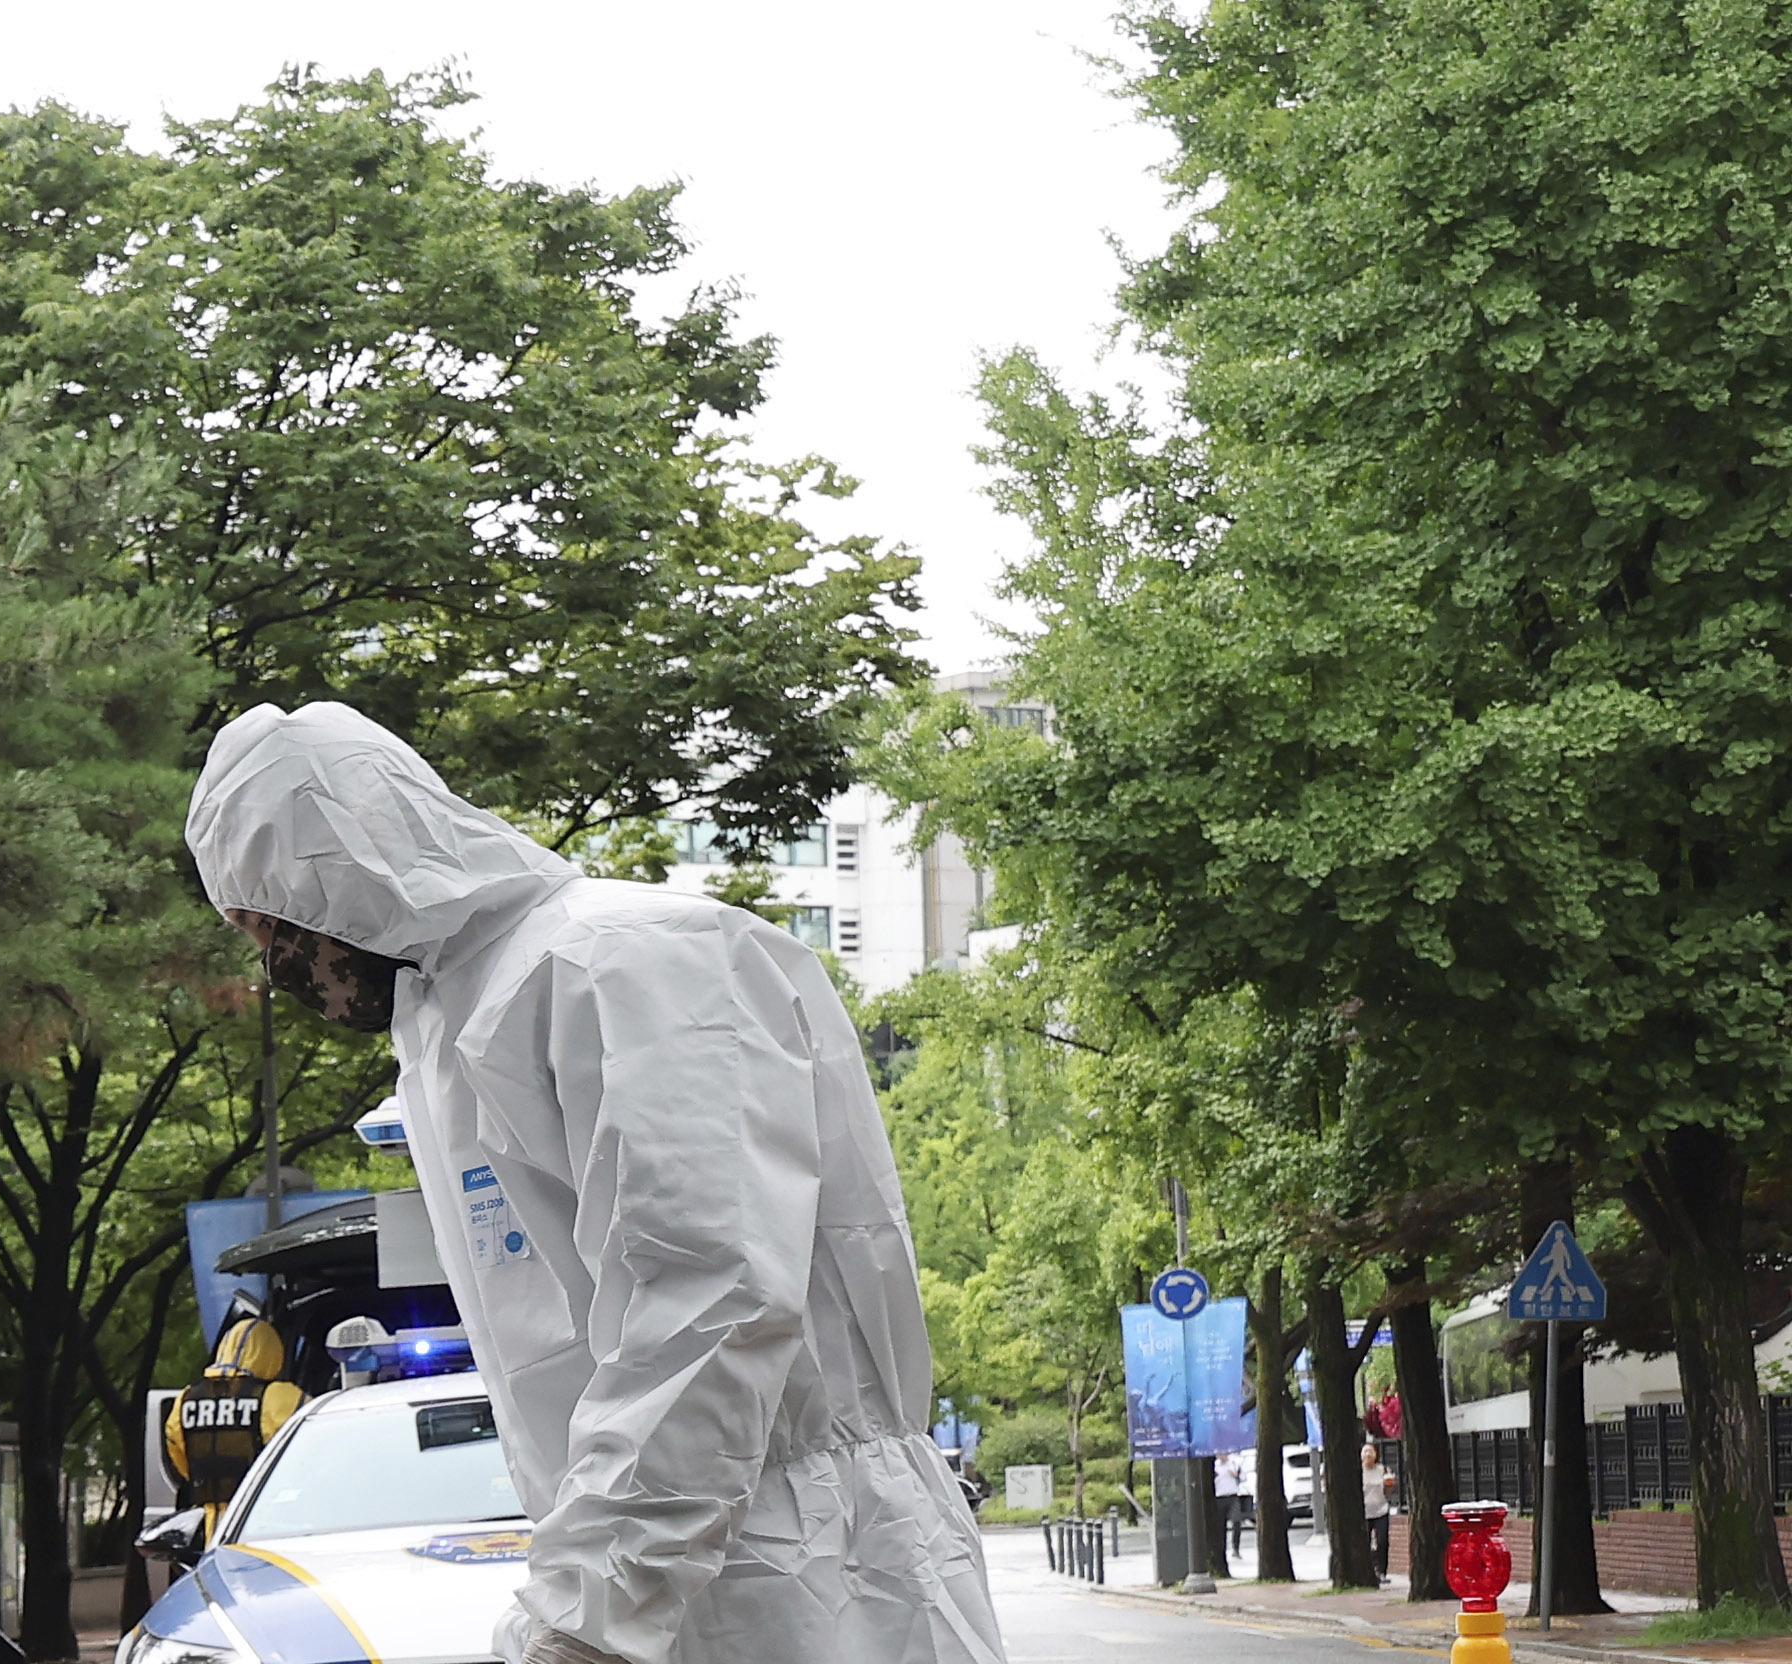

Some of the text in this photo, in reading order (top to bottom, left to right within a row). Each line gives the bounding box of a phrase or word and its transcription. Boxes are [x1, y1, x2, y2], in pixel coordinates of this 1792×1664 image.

[1524, 1303, 1591, 1317] 횡단보도
[182, 1398, 258, 1429] CRRT
[455, 1550, 528, 1561] POLIC
